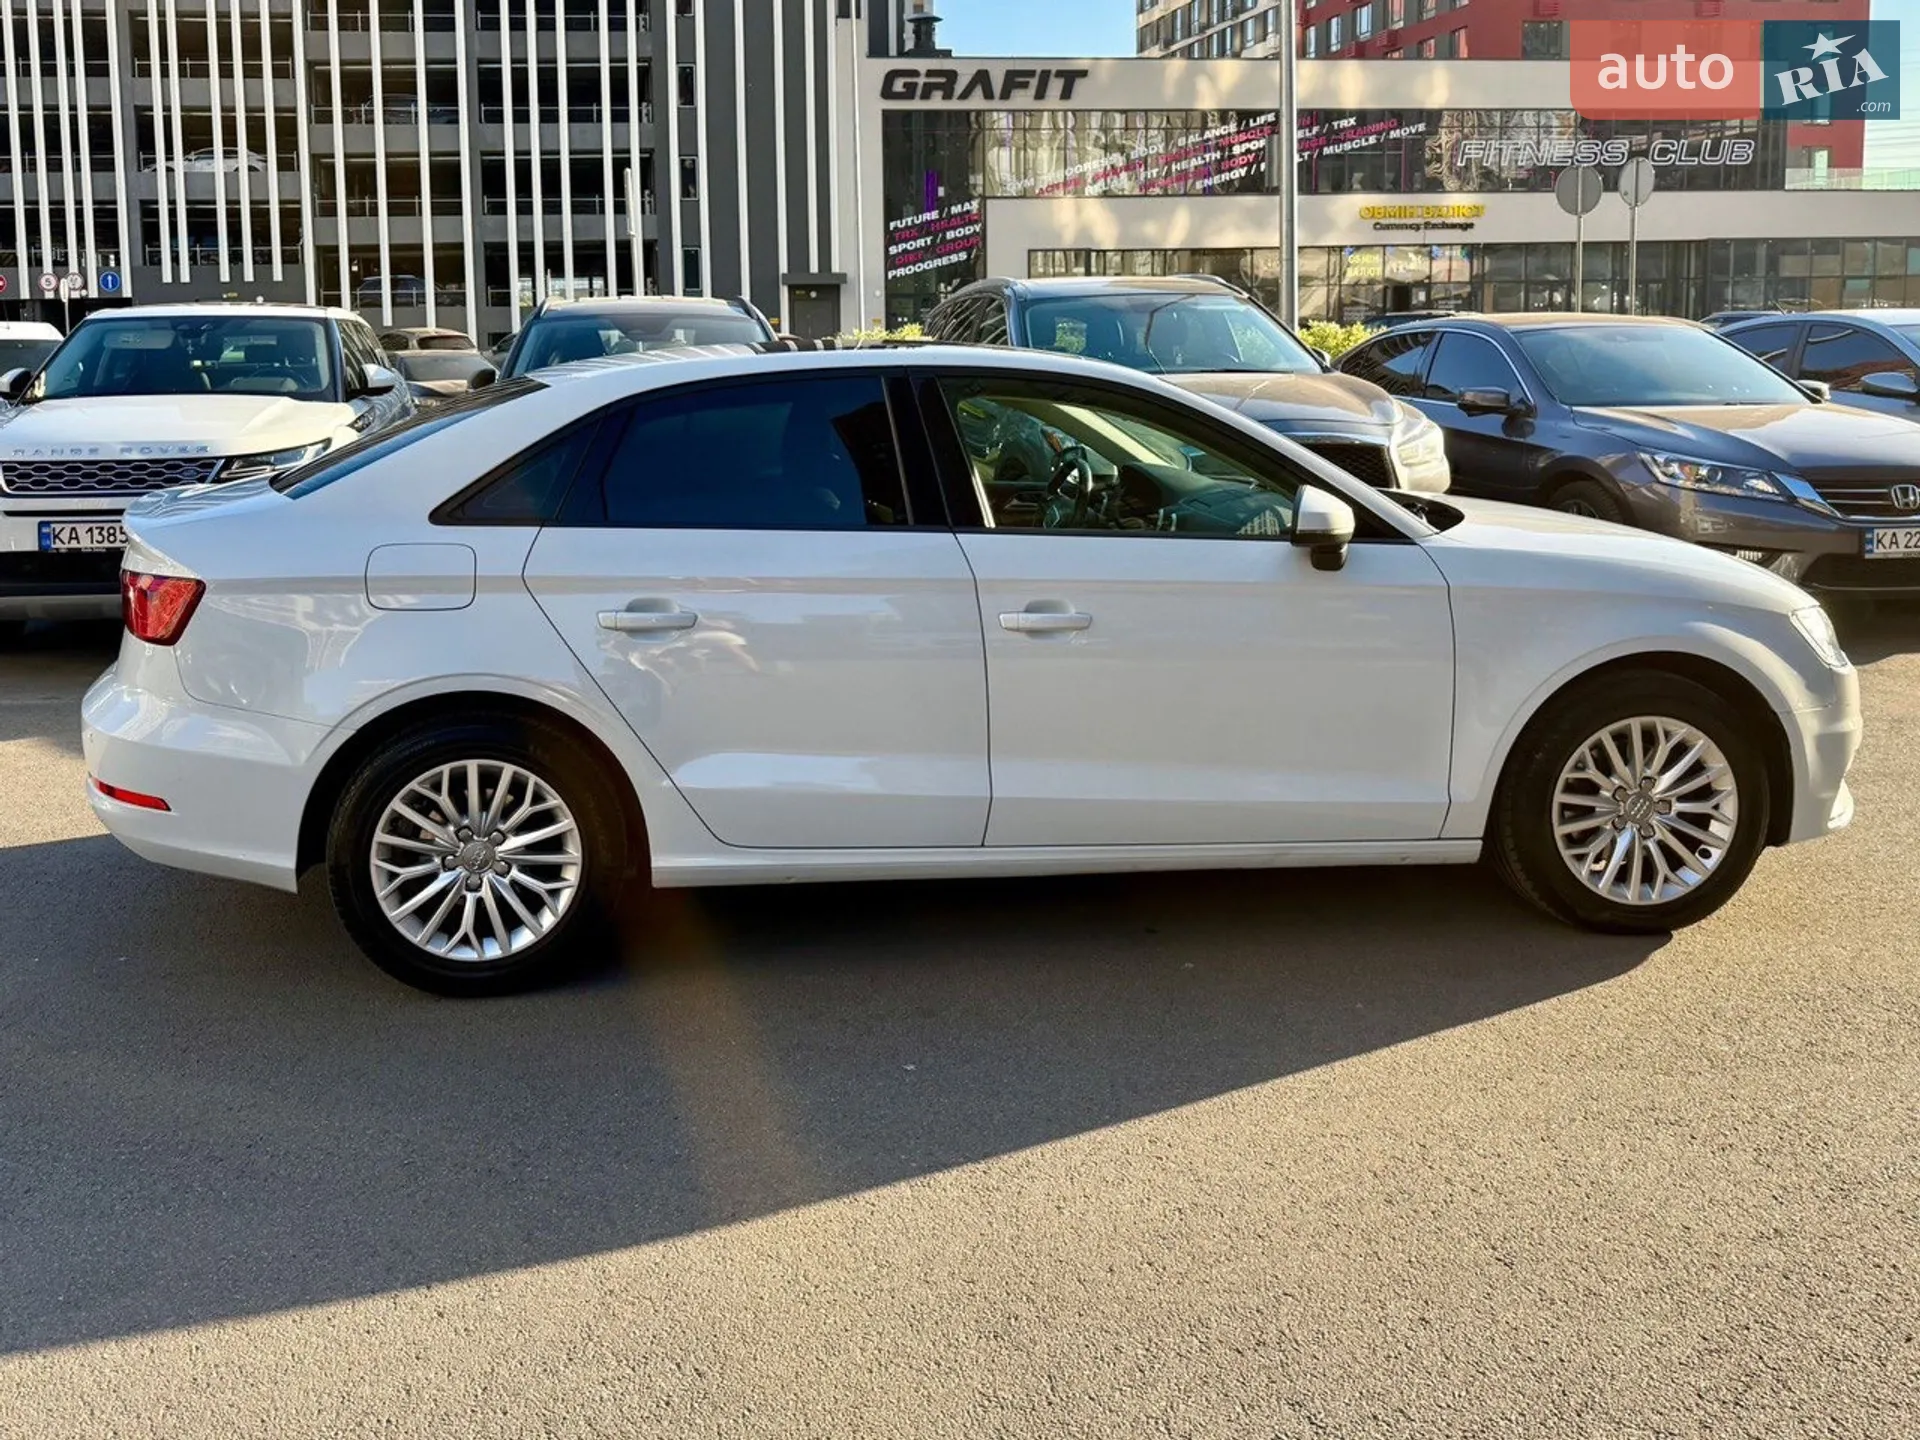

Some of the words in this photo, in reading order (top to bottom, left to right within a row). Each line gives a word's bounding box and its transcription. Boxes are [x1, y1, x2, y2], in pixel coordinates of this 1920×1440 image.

[880, 69, 1089, 100] GRAFIT
[1130, 143, 1165, 159] BODY
[1178, 122, 1238, 147] BALANCE
[1249, 112, 1276, 126] LIFE
[1172, 150, 1221, 173] HEALTH
[1297, 125, 1320, 139] ELF
[1331, 117, 1357, 130] TRX
[1195, 167, 1248, 190] ENERGY
[1323, 135, 1377, 155] MUSCLE
[1389, 122, 1426, 139] MOVE
[1221, 153, 1257, 171] BODY
[1457, 139, 1629, 166] FITNESS
[1650, 139, 1755, 165] CLUB
[889, 210, 940, 231] FUTURE
[950, 199, 979, 215] MAX
[1424, 220, 1475, 232] Exchange
[889, 236, 933, 255] SPORT
[946, 223, 982, 240] BODY
[894, 227, 919, 241] TRX
[936, 235, 981, 255] GROUP
[888, 251, 968, 280] PROOGRESS
[44, 277, 53, 288] 5
[12, 448, 100, 456] RANGE
[119, 446, 210, 455] ROVER
[52, 526, 80, 545] KA
[85, 526, 129, 544] 1385
[1876, 531, 1900, 550] KA
